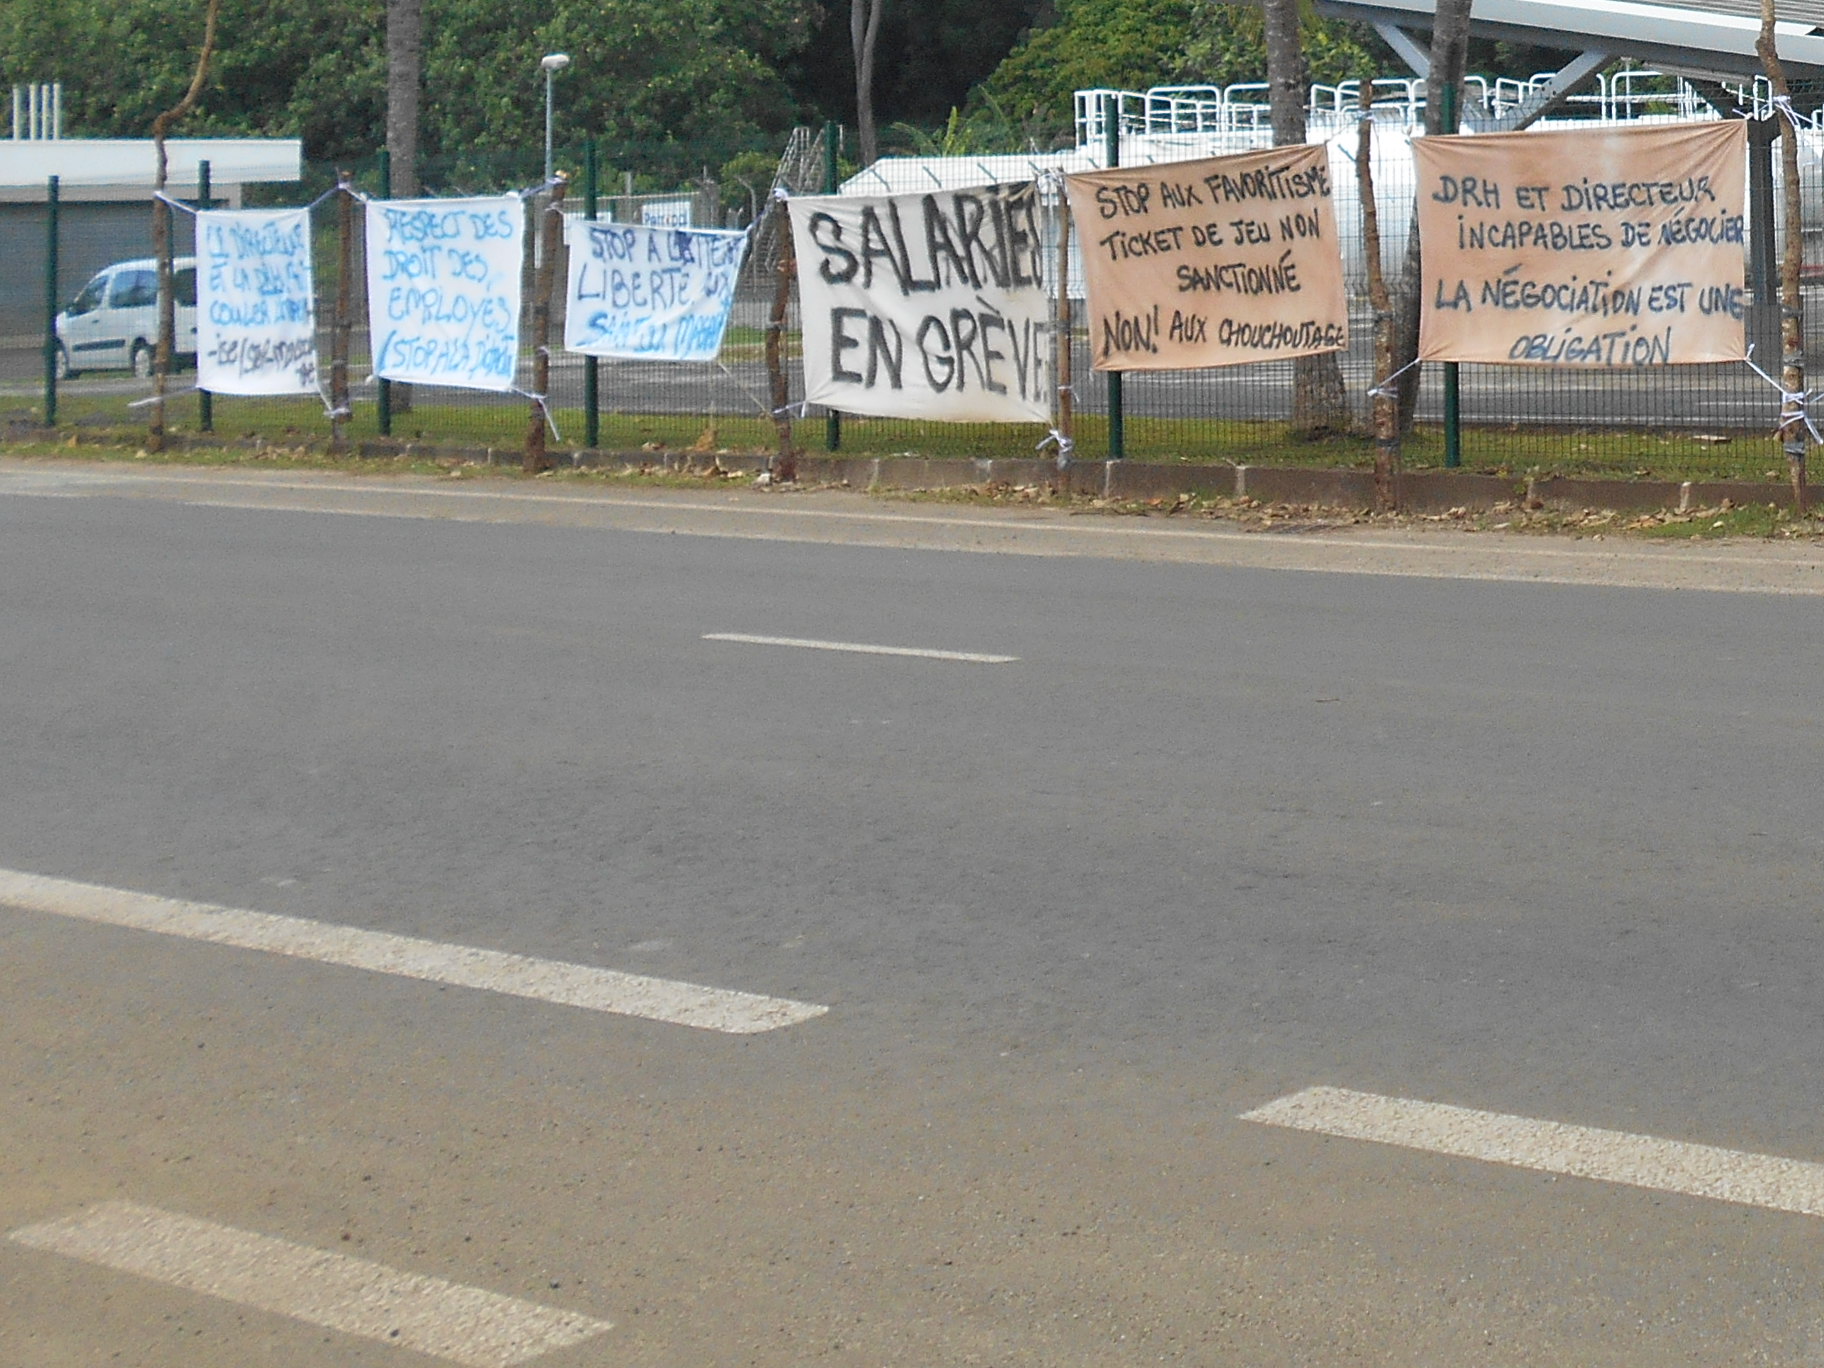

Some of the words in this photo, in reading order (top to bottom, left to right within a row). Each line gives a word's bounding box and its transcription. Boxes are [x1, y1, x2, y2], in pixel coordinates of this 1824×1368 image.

[1095, 182, 1150, 220] STOP
[1159, 180, 1204, 209] AUX
[1431, 175, 1501, 210] DRH
[1515, 185, 1550, 212] ET
[1561, 175, 1716, 212] DIRECTEUR
[468, 210, 514, 241] DES
[1099, 225, 1184, 261] TICKET
[1193, 222, 1224, 247] DE
[1229, 219, 1271, 245] JEU
[1279, 207, 1321, 242] NON
[1457, 214, 1613, 251] INCAPABLES
[1620, 221, 1652, 248] DE
[381, 245, 442, 281] DROIT
[447, 249, 489, 283] DES
[1434, 278, 1472, 313] LA
[1648, 282, 1693, 313] EST
[1697, 282, 1745, 321] UNE
[1168, 309, 1208, 344] AUX
[1507, 324, 1673, 367] OBLIGATION
[830, 307, 904, 390] EN
